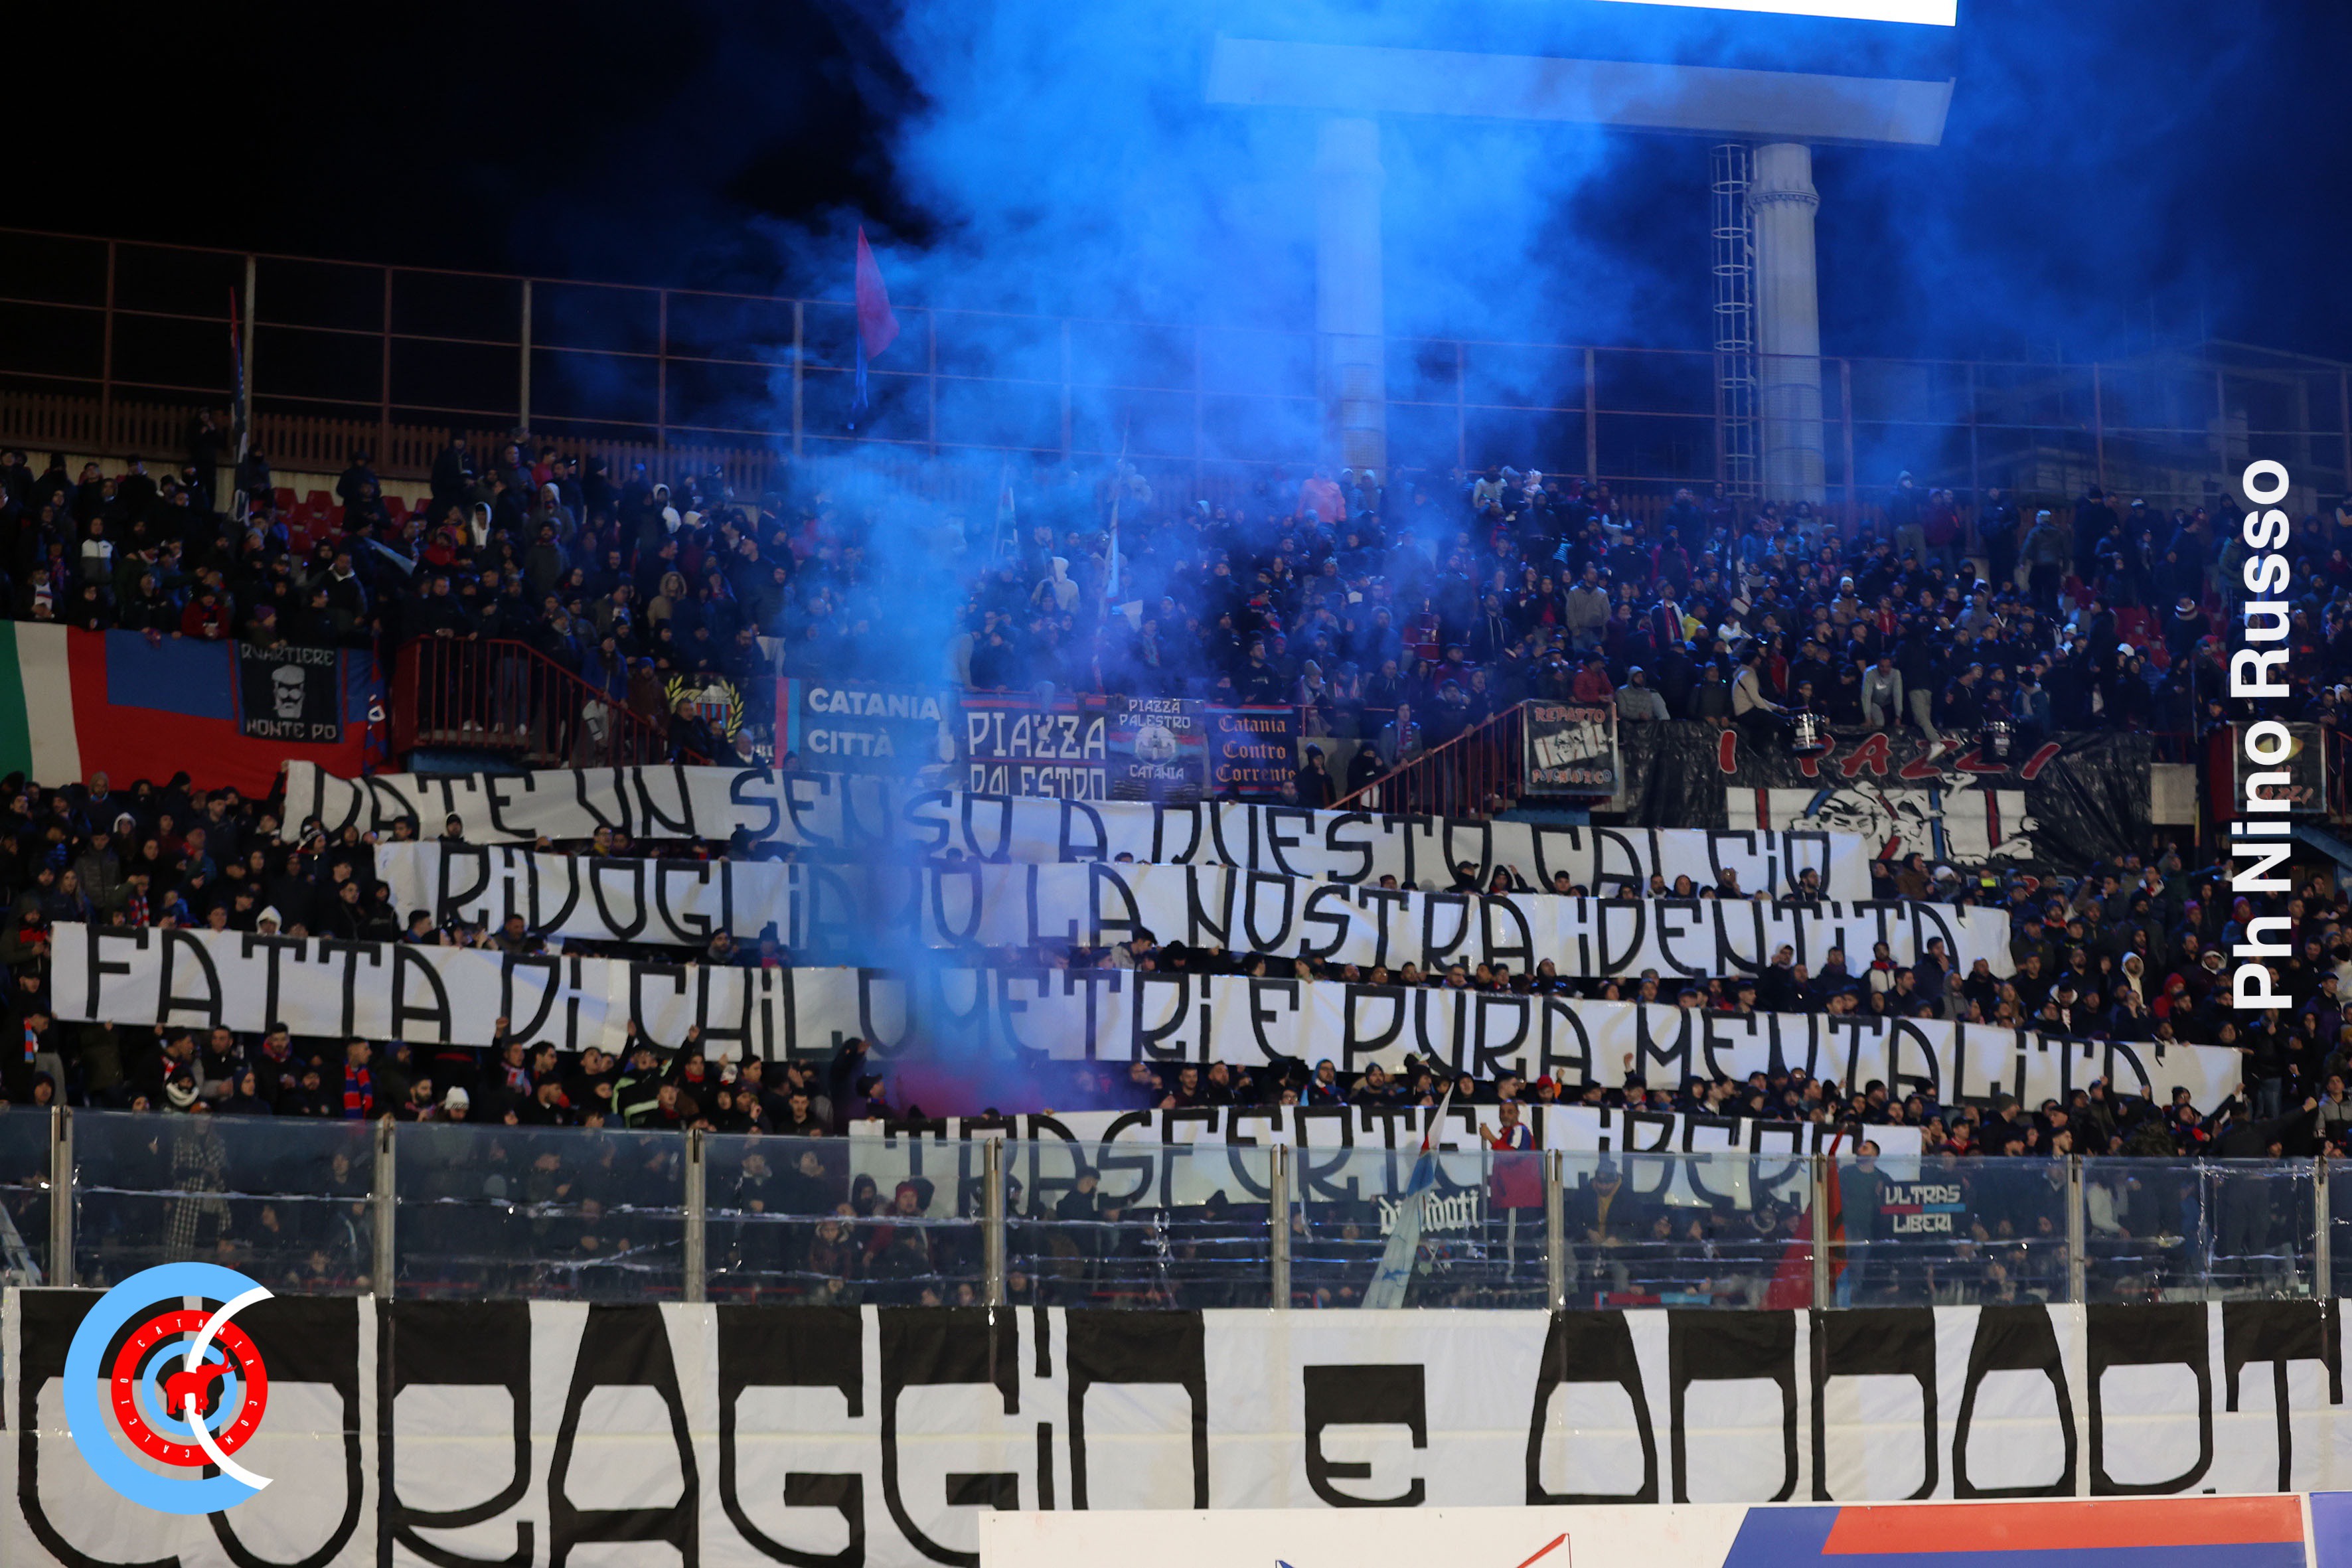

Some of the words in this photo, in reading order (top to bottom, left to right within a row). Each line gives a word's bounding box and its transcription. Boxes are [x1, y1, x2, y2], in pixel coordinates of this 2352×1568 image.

[809, 688, 941, 722] CATANIA
[1129, 699, 1180, 714] PIAZZA
[1535, 707, 1607, 724] REPARTO
[246, 719, 305, 738] MONTE
[311, 724, 337, 740] PO
[1119, 714, 1191, 729] PALESTRO
[1218, 715, 1287, 733] Catania
[807, 728, 895, 757] CITTÀ
[967, 712, 1105, 761] PIAZZA
[1223, 740, 1287, 759] Contro
[1718, 729, 1738, 774] I
[1129, 765, 1184, 780] CATANIA
[1216, 763, 1296, 782] Corrente
[313, 763, 536, 842] DATE
[575, 765, 696, 838] UN
[730, 767, 1013, 864] SENSO
[1059, 799, 1107, 862] A
[1152, 802, 1491, 893] QUESTO
[1027, 862, 1140, 948] LA
[1187, 864, 1535, 977] NOSTRA
[86, 926, 451, 1045] FATTA
[1249, 977, 1299, 1061] E
[1344, 984, 1592, 1085] PURA
[1885, 1184, 1960, 1205] ULTRAS
[1378, 1189, 1480, 1235] diidati
[1893, 1213, 1952, 1233] LIBERI
[1304, 1364, 1427, 1508] E
